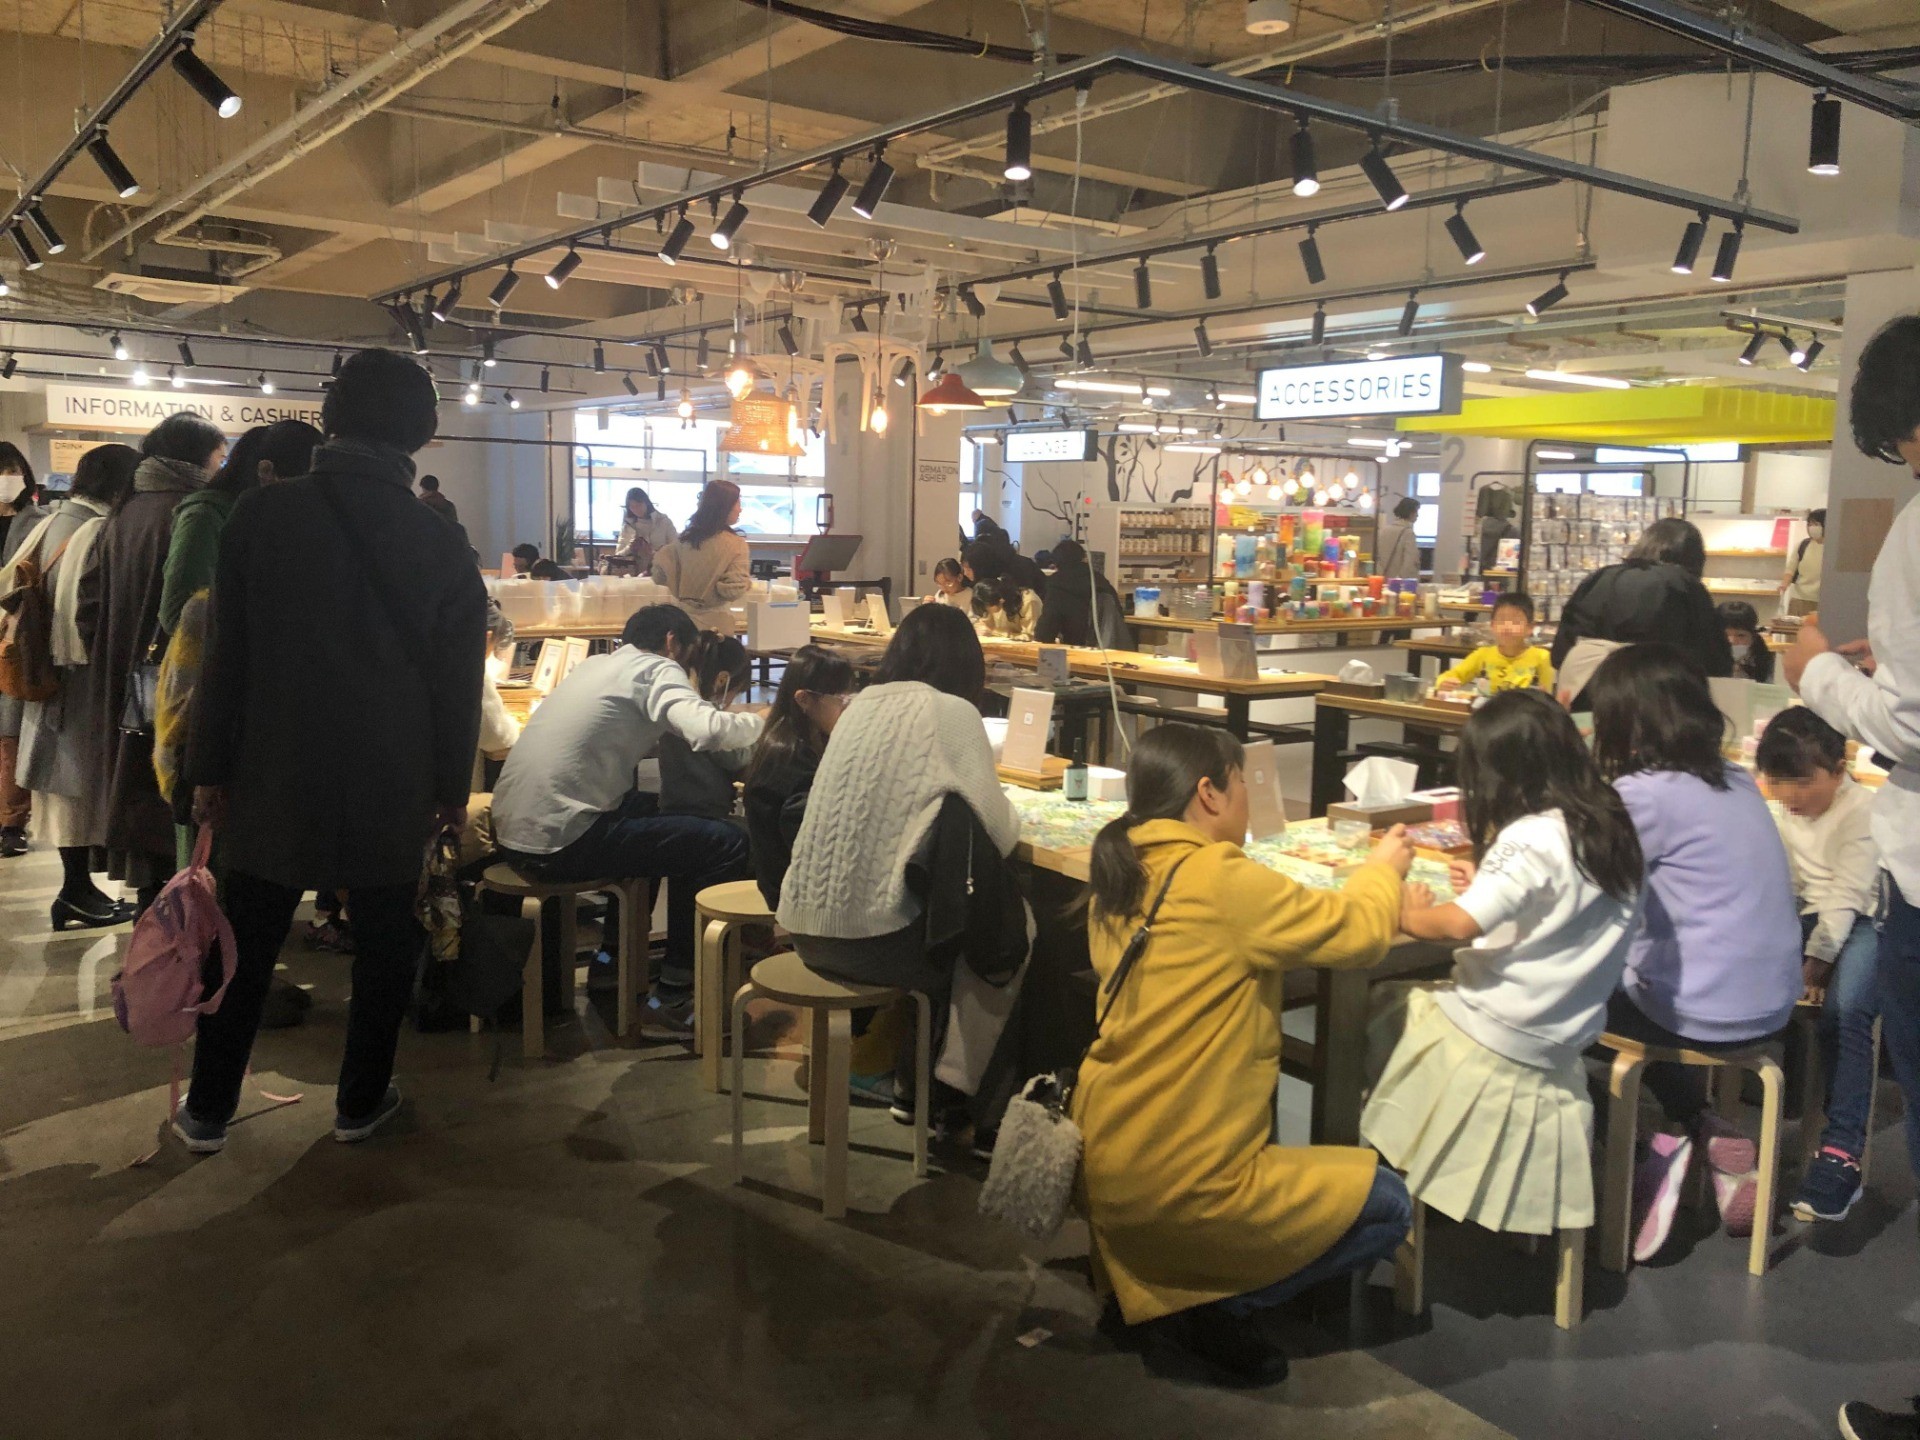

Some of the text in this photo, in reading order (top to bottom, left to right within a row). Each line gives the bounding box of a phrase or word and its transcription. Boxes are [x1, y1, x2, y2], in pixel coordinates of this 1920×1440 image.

[1270, 373, 1431, 405] ACCESSORIES
[220, 405, 235, 423] &
[1442, 437, 1466, 483] 2
